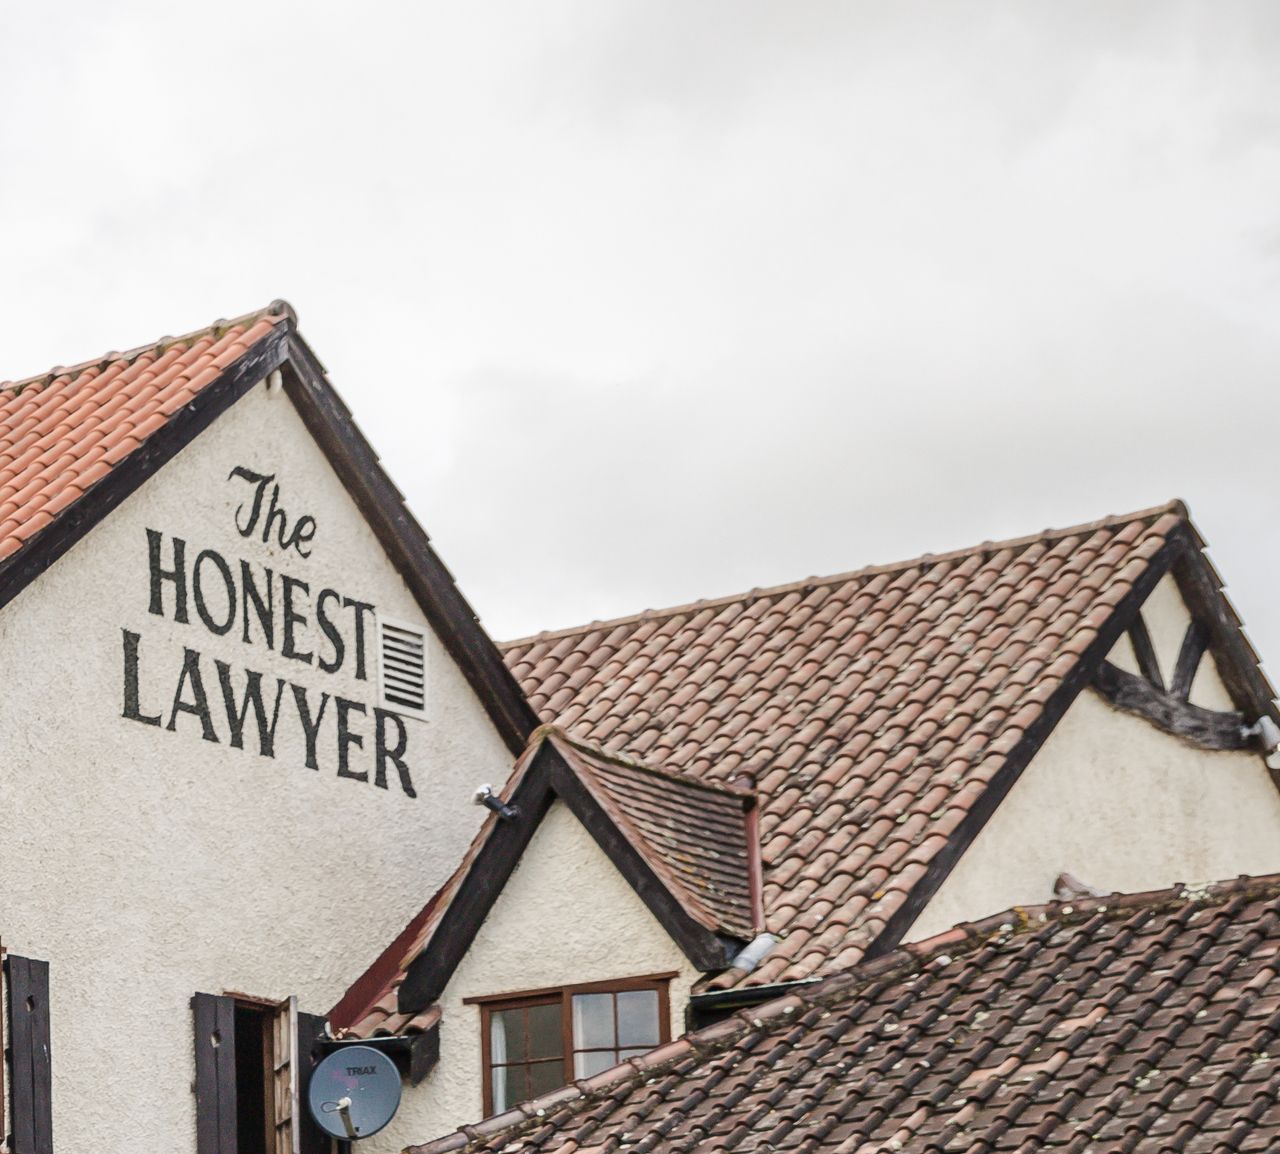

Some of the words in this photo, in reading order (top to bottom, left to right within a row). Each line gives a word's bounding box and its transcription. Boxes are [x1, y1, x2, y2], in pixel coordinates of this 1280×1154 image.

[227, 465, 317, 559] The
[145, 527, 376, 681] HONEST
[120, 627, 417, 799] LAWYER
